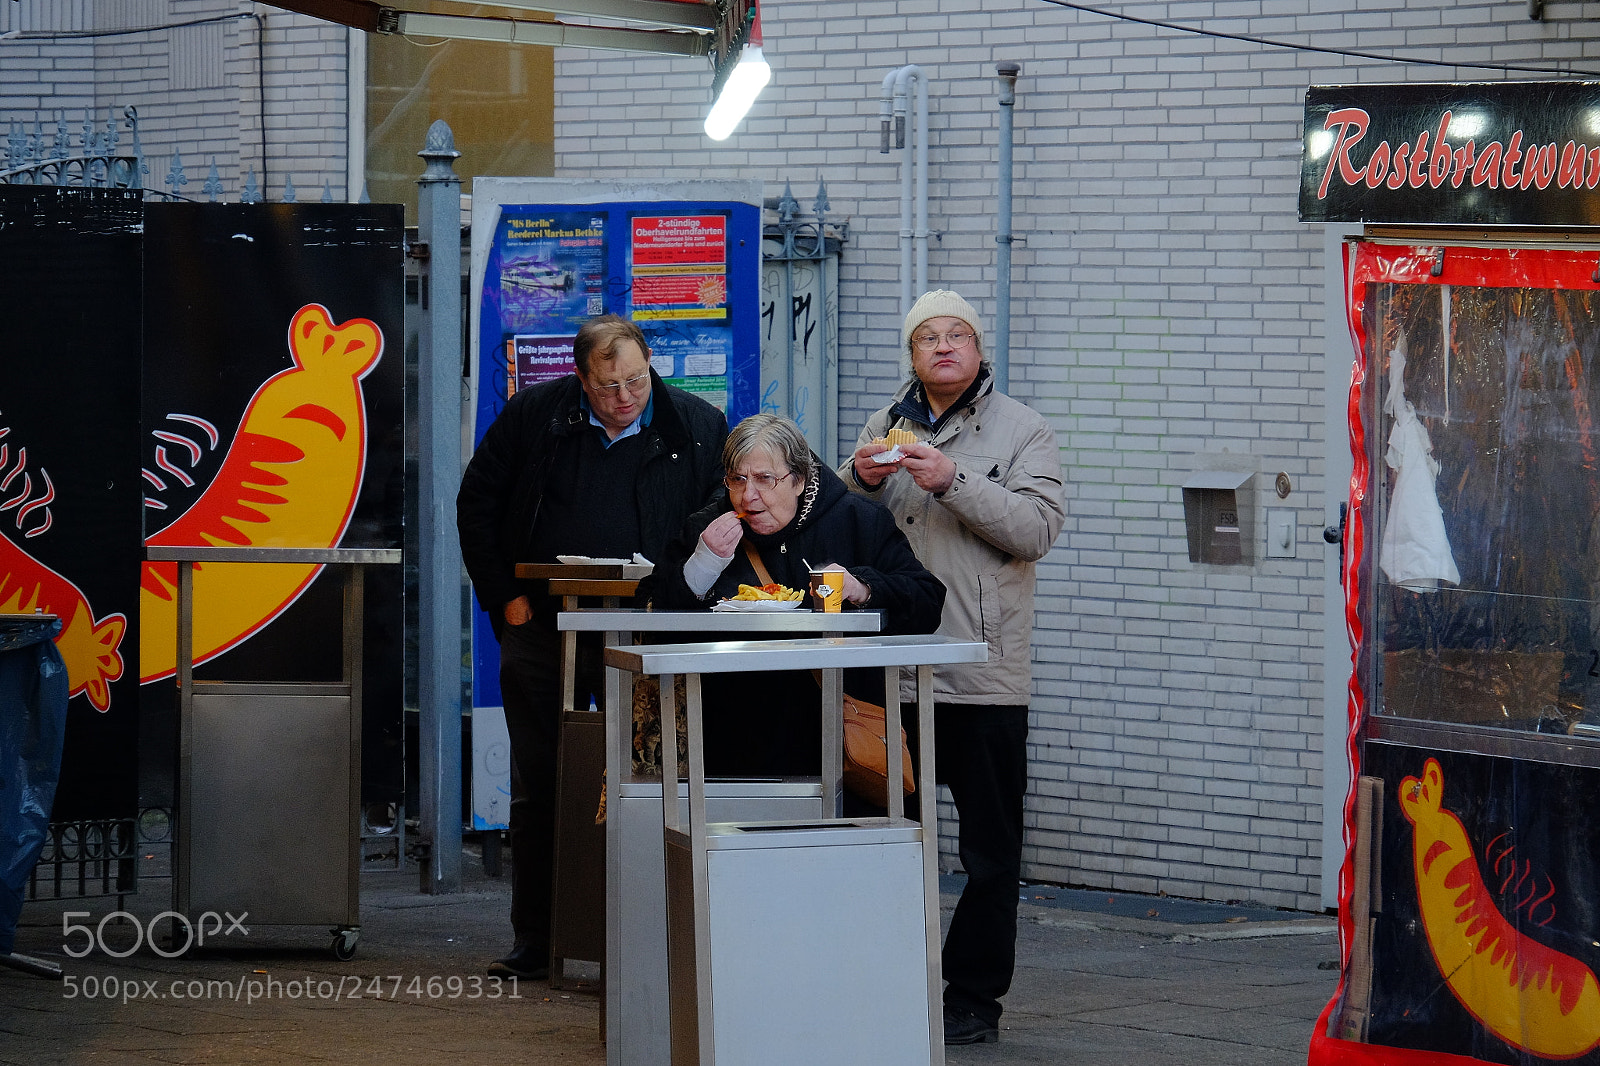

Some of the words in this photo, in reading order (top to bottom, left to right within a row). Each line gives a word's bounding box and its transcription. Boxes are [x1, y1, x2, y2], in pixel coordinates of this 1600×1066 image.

[658, 219, 700, 228] 2-stündige
[508, 230, 543, 238] Reederei
[544, 229, 574, 237] Markus
[575, 228, 603, 237] Bethke
[635, 228, 723, 237] Oberhavelrundfahrten
[530, 356, 564, 365] Revivalparty
